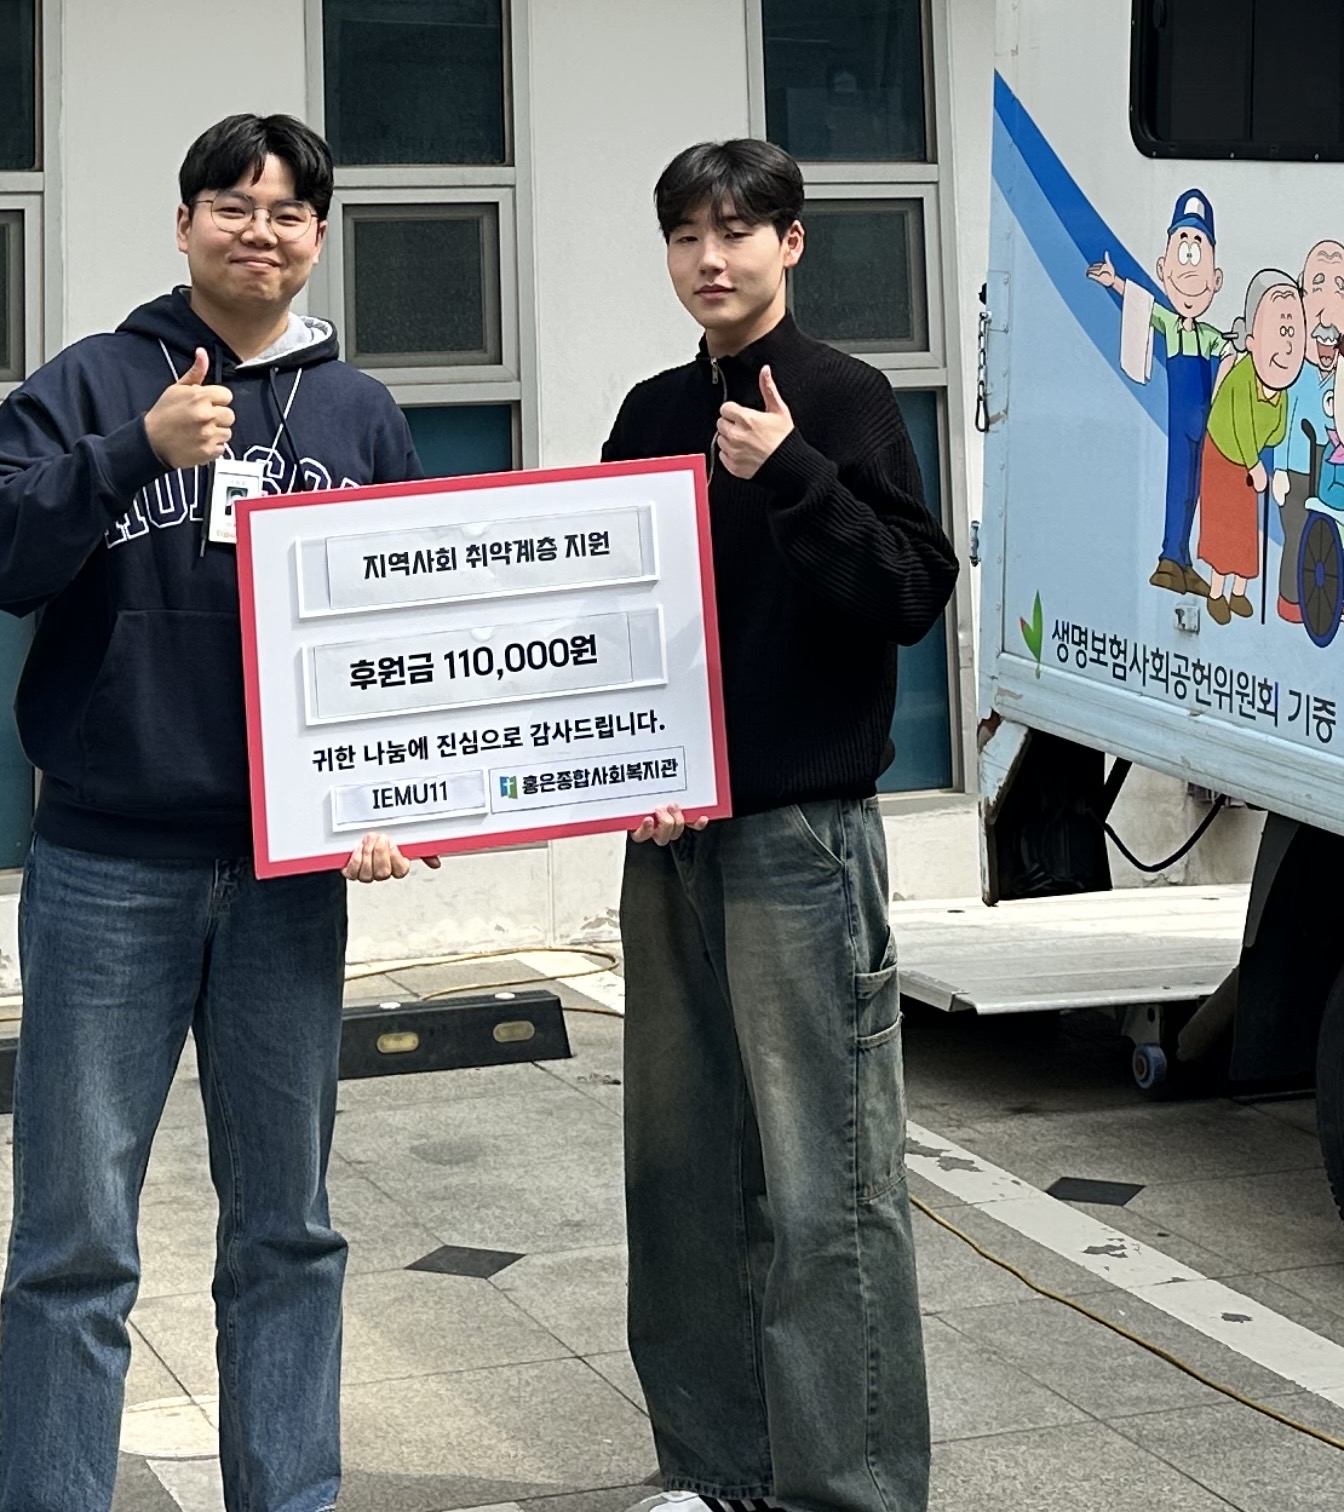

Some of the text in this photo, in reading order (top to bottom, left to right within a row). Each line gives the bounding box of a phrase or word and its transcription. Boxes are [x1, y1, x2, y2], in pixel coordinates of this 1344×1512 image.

[363, 531, 610, 580] 지역사회 취약계층 지원
[349, 633, 598, 690] 후원금 110,000원
[1052, 619, 1336, 744] 생명보험사회공헌위원회 기증
[312, 709, 666, 773] 귀한 나눔에 진심으로 감사드립니다.
[372, 781, 448, 810] IEMU11
[521, 757, 678, 795] 홍은종합사회복지관
